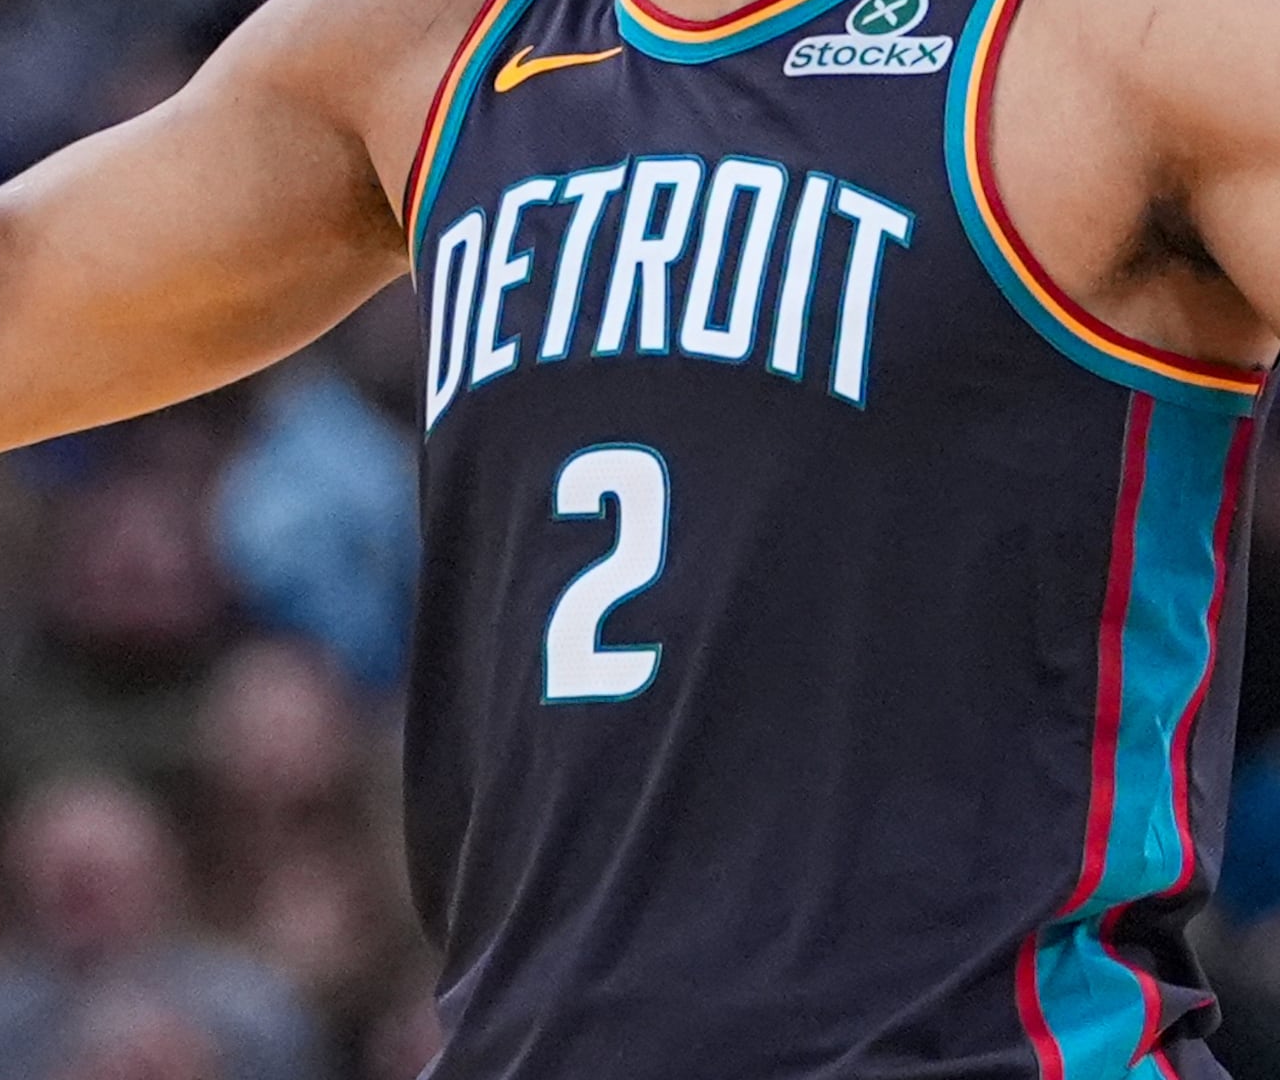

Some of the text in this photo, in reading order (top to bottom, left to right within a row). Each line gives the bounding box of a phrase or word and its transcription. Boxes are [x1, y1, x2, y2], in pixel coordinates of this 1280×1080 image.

[790, 41, 946, 68] StockX
[425, 154, 915, 438] DETROIT
[540, 443, 670, 705] 2
